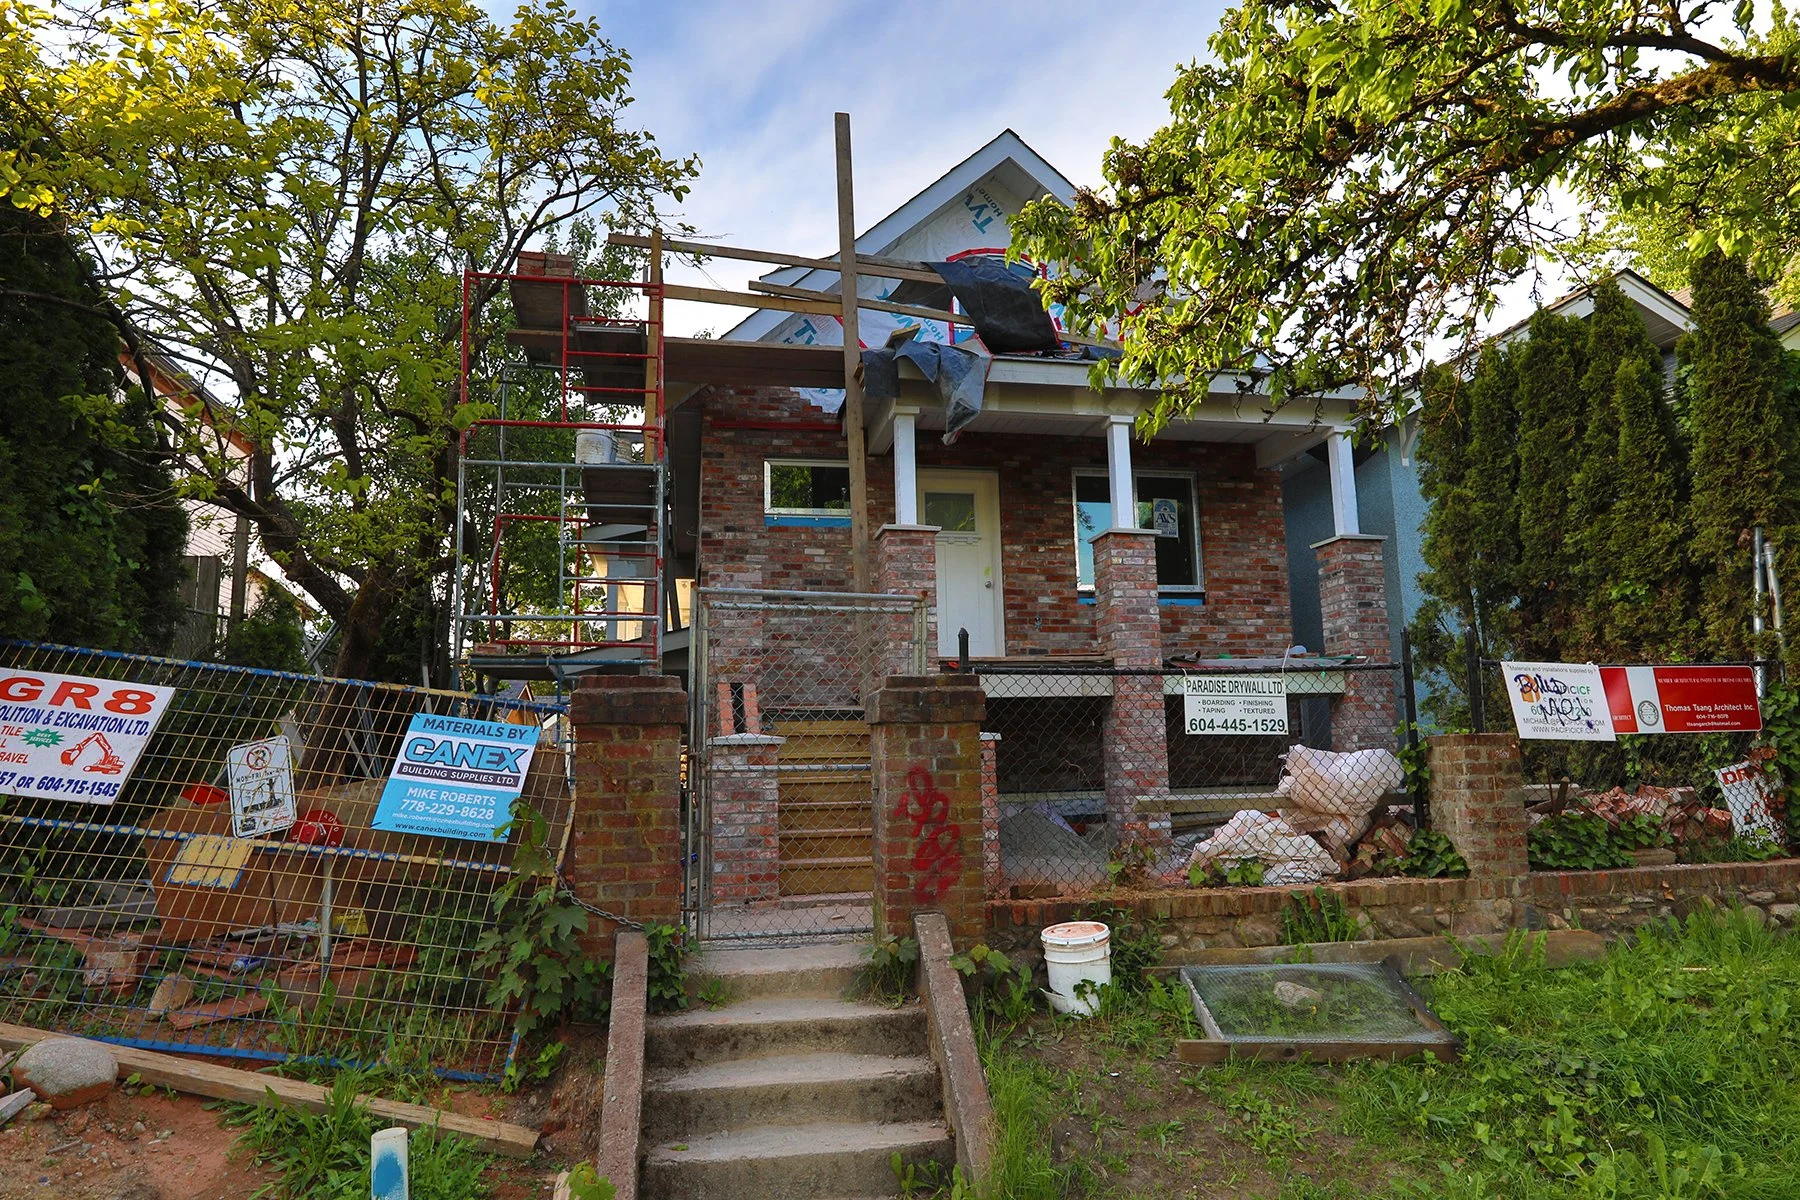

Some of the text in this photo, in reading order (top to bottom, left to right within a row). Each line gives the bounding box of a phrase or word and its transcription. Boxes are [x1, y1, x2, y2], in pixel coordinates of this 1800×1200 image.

[0, 677, 156, 715] GR8
[1187, 680, 1285, 694] PARADISE DRYWALL LTD.
[1665, 703, 1755, 712] Thomas Tsang Architect Inc.
[1, 725, 24, 736] TILE
[42, 710, 54, 725] &
[53, 711, 126, 733] EXCAVATION
[124, 720, 149, 736] LTD.
[423, 718, 528, 740] MATERIALS BY
[1190, 718, 1285, 732] 604-445-1529
[404, 737, 528, 773] CANEX
[16, 776, 34, 788] OR
[402, 765, 515, 785] BUILDING SUPPLIES LTD.
[407, 787, 497, 806] MIKE ROBERTS
[400, 799, 495, 820] 778-229-8628
[395, 823, 486, 838] www.canexbuilding.com
